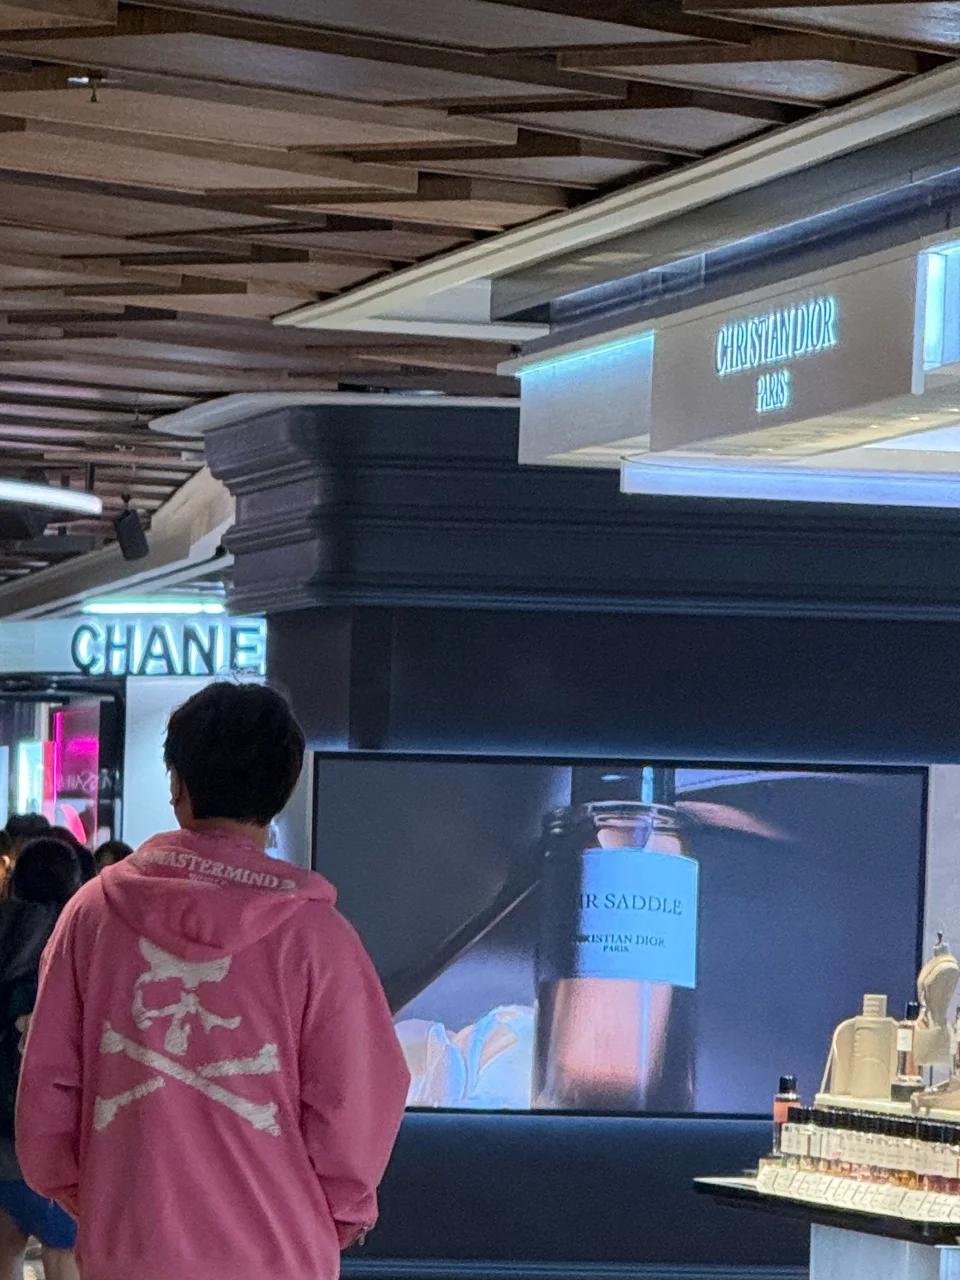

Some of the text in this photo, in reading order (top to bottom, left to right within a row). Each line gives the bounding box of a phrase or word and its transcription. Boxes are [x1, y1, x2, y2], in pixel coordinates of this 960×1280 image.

[717, 296, 837, 376] CHRISTIAN DIOR
[756, 368, 789, 412] PARIS
[604, 893, 682, 916] SADDLE
[635, 934, 665, 948] DIOR
